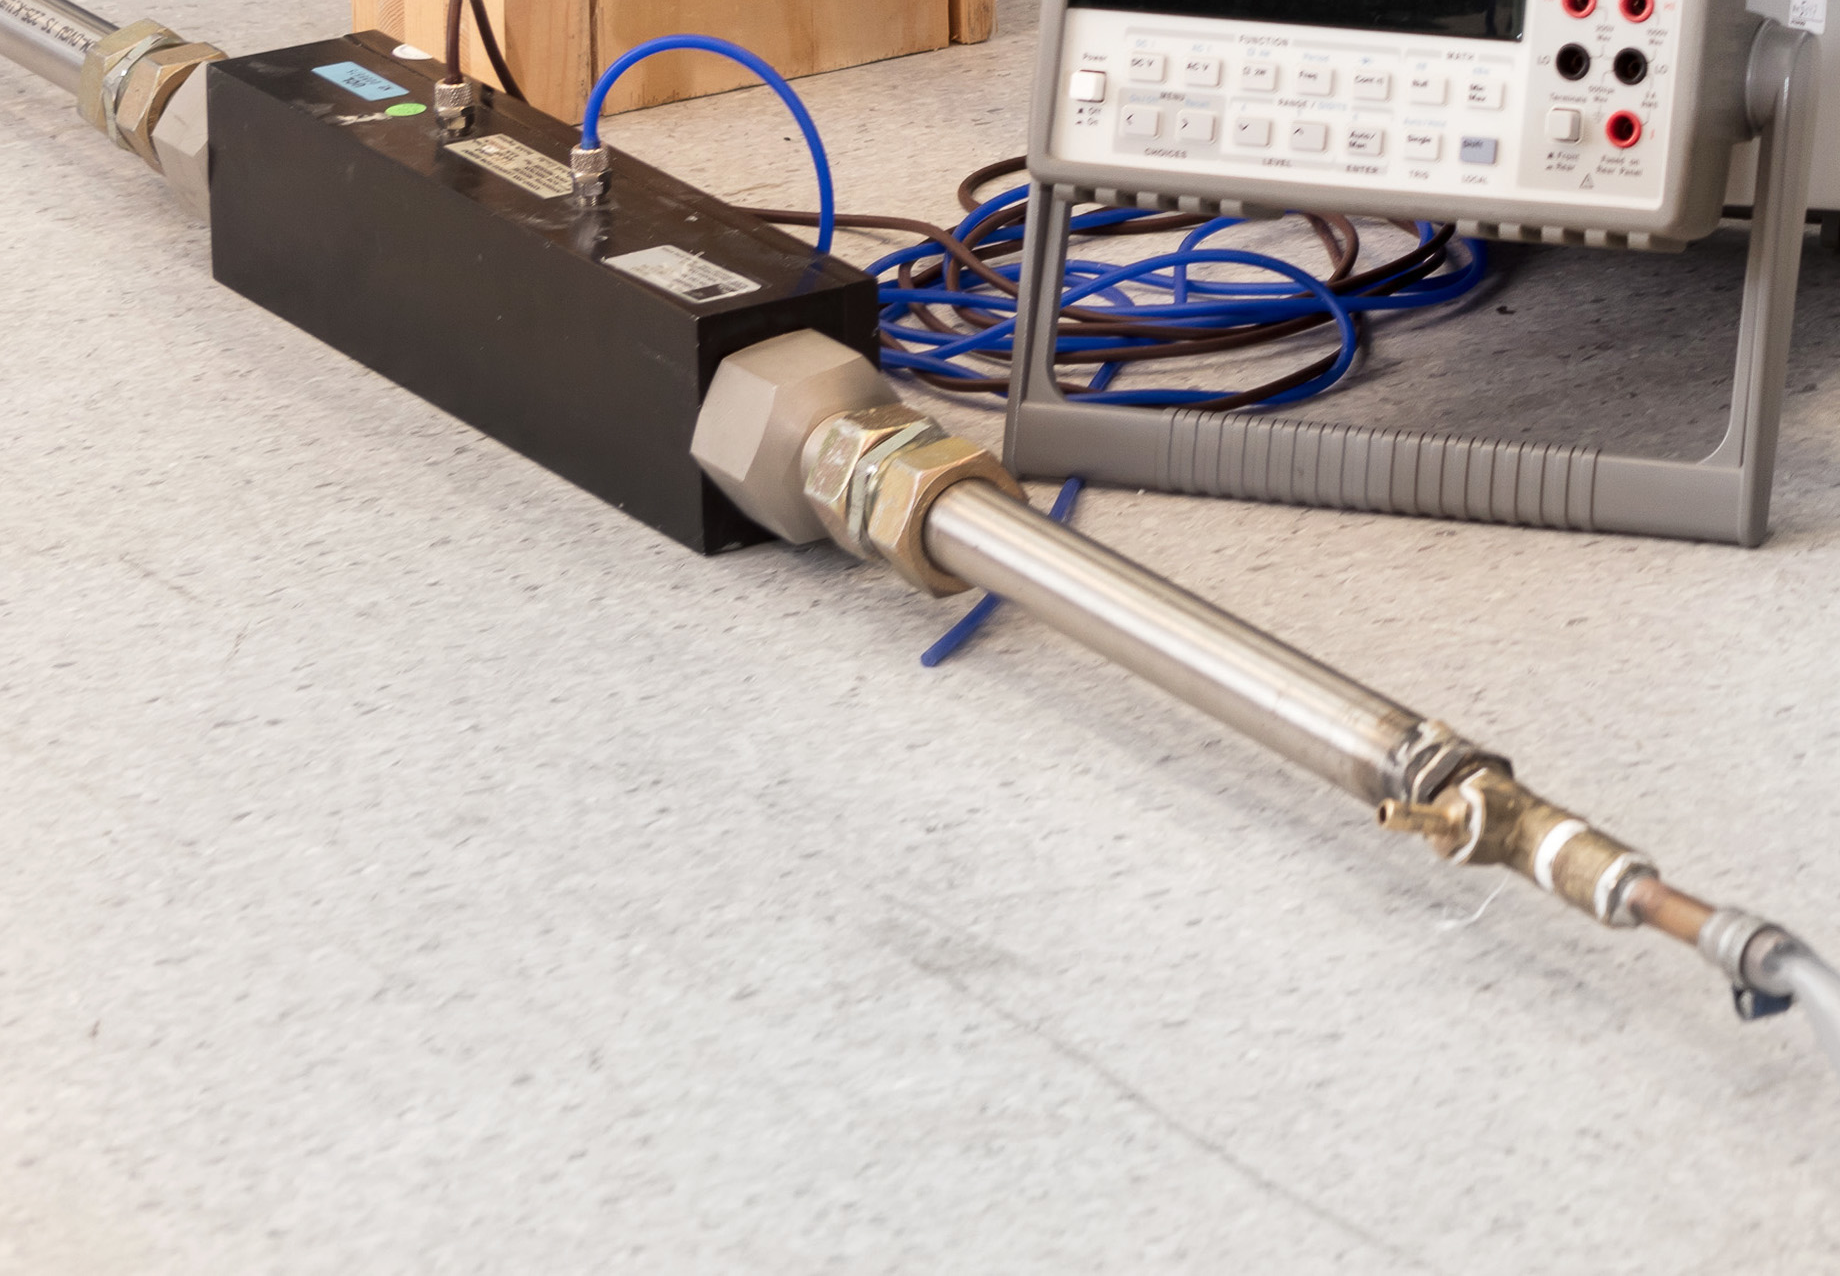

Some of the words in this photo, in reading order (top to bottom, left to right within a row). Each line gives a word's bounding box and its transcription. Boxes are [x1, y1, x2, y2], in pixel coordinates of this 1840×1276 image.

[1239, 34, 1289, 47] FUNCTION
[1144, 147, 1188, 159] CHOICES
[1262, 158, 1292, 168] LEVEL
[1346, 165, 1379, 175] ENTER
